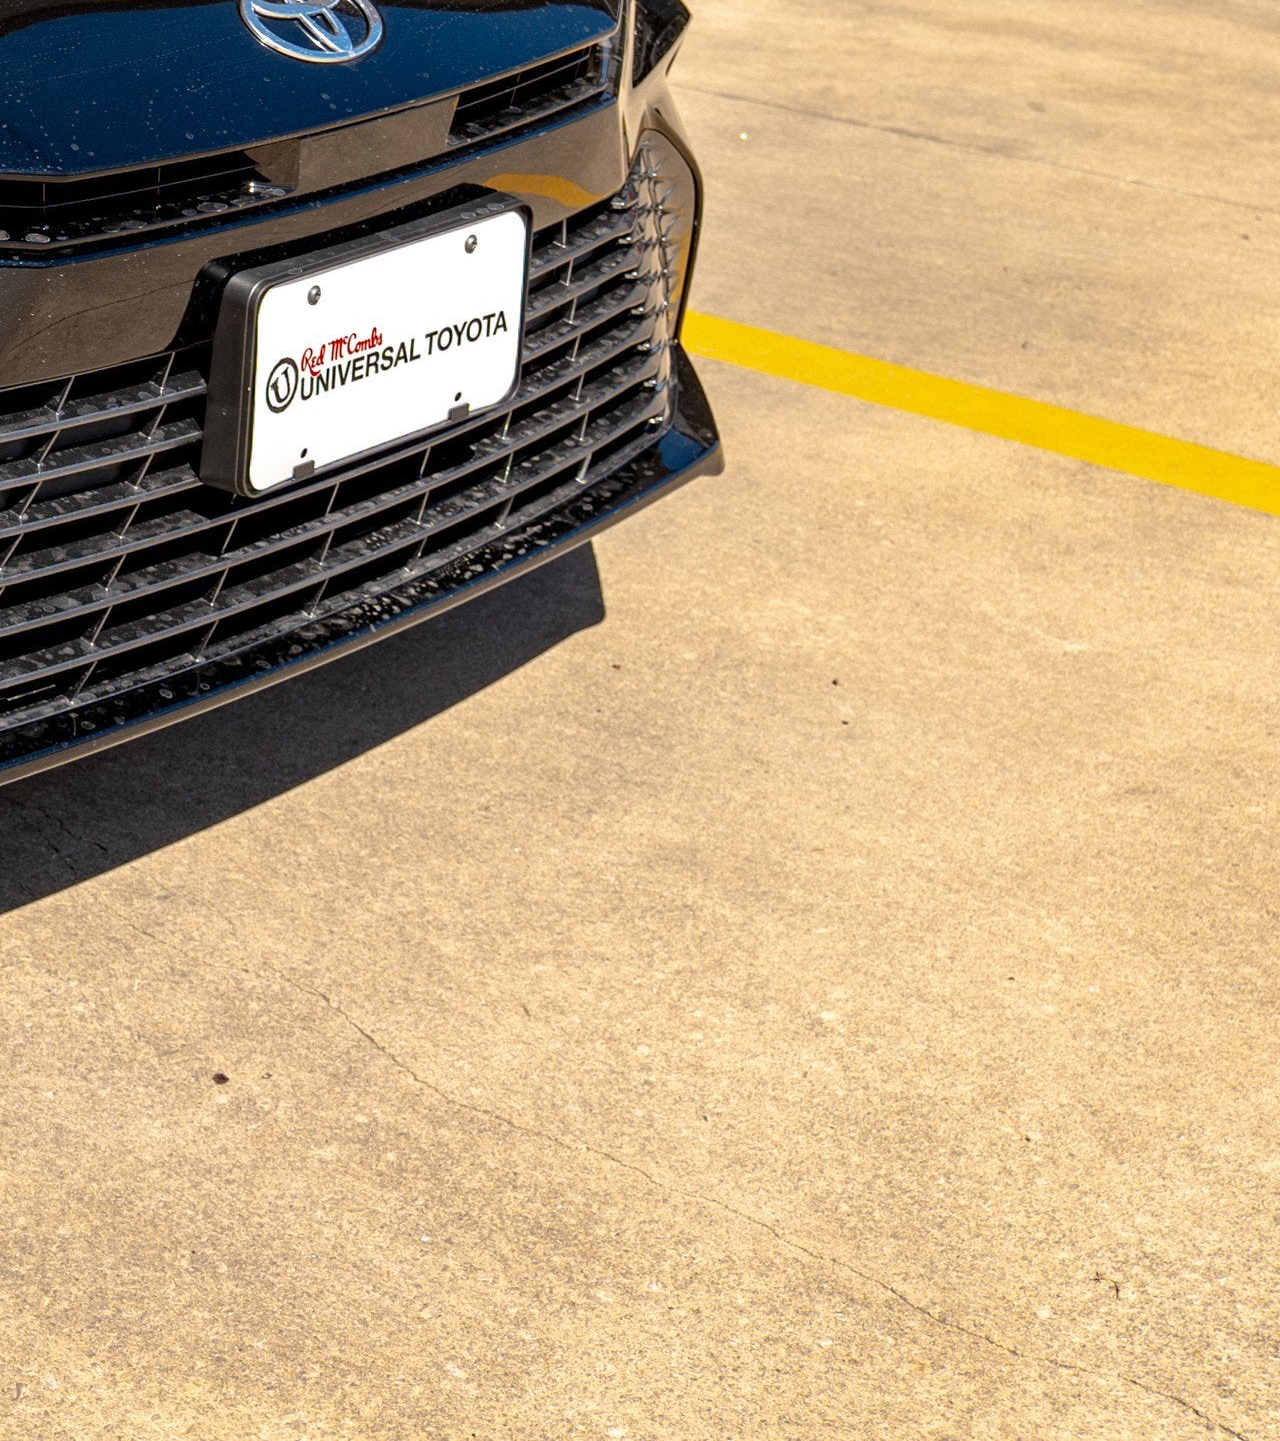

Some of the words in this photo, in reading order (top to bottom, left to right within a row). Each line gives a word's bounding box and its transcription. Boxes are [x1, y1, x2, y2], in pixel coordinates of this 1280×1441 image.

[300, 338, 422, 401] UNIVERSAL
[425, 310, 508, 355] TOYOTA
[301, 344, 326, 377] Red
[328, 326, 383, 361] McCombs
